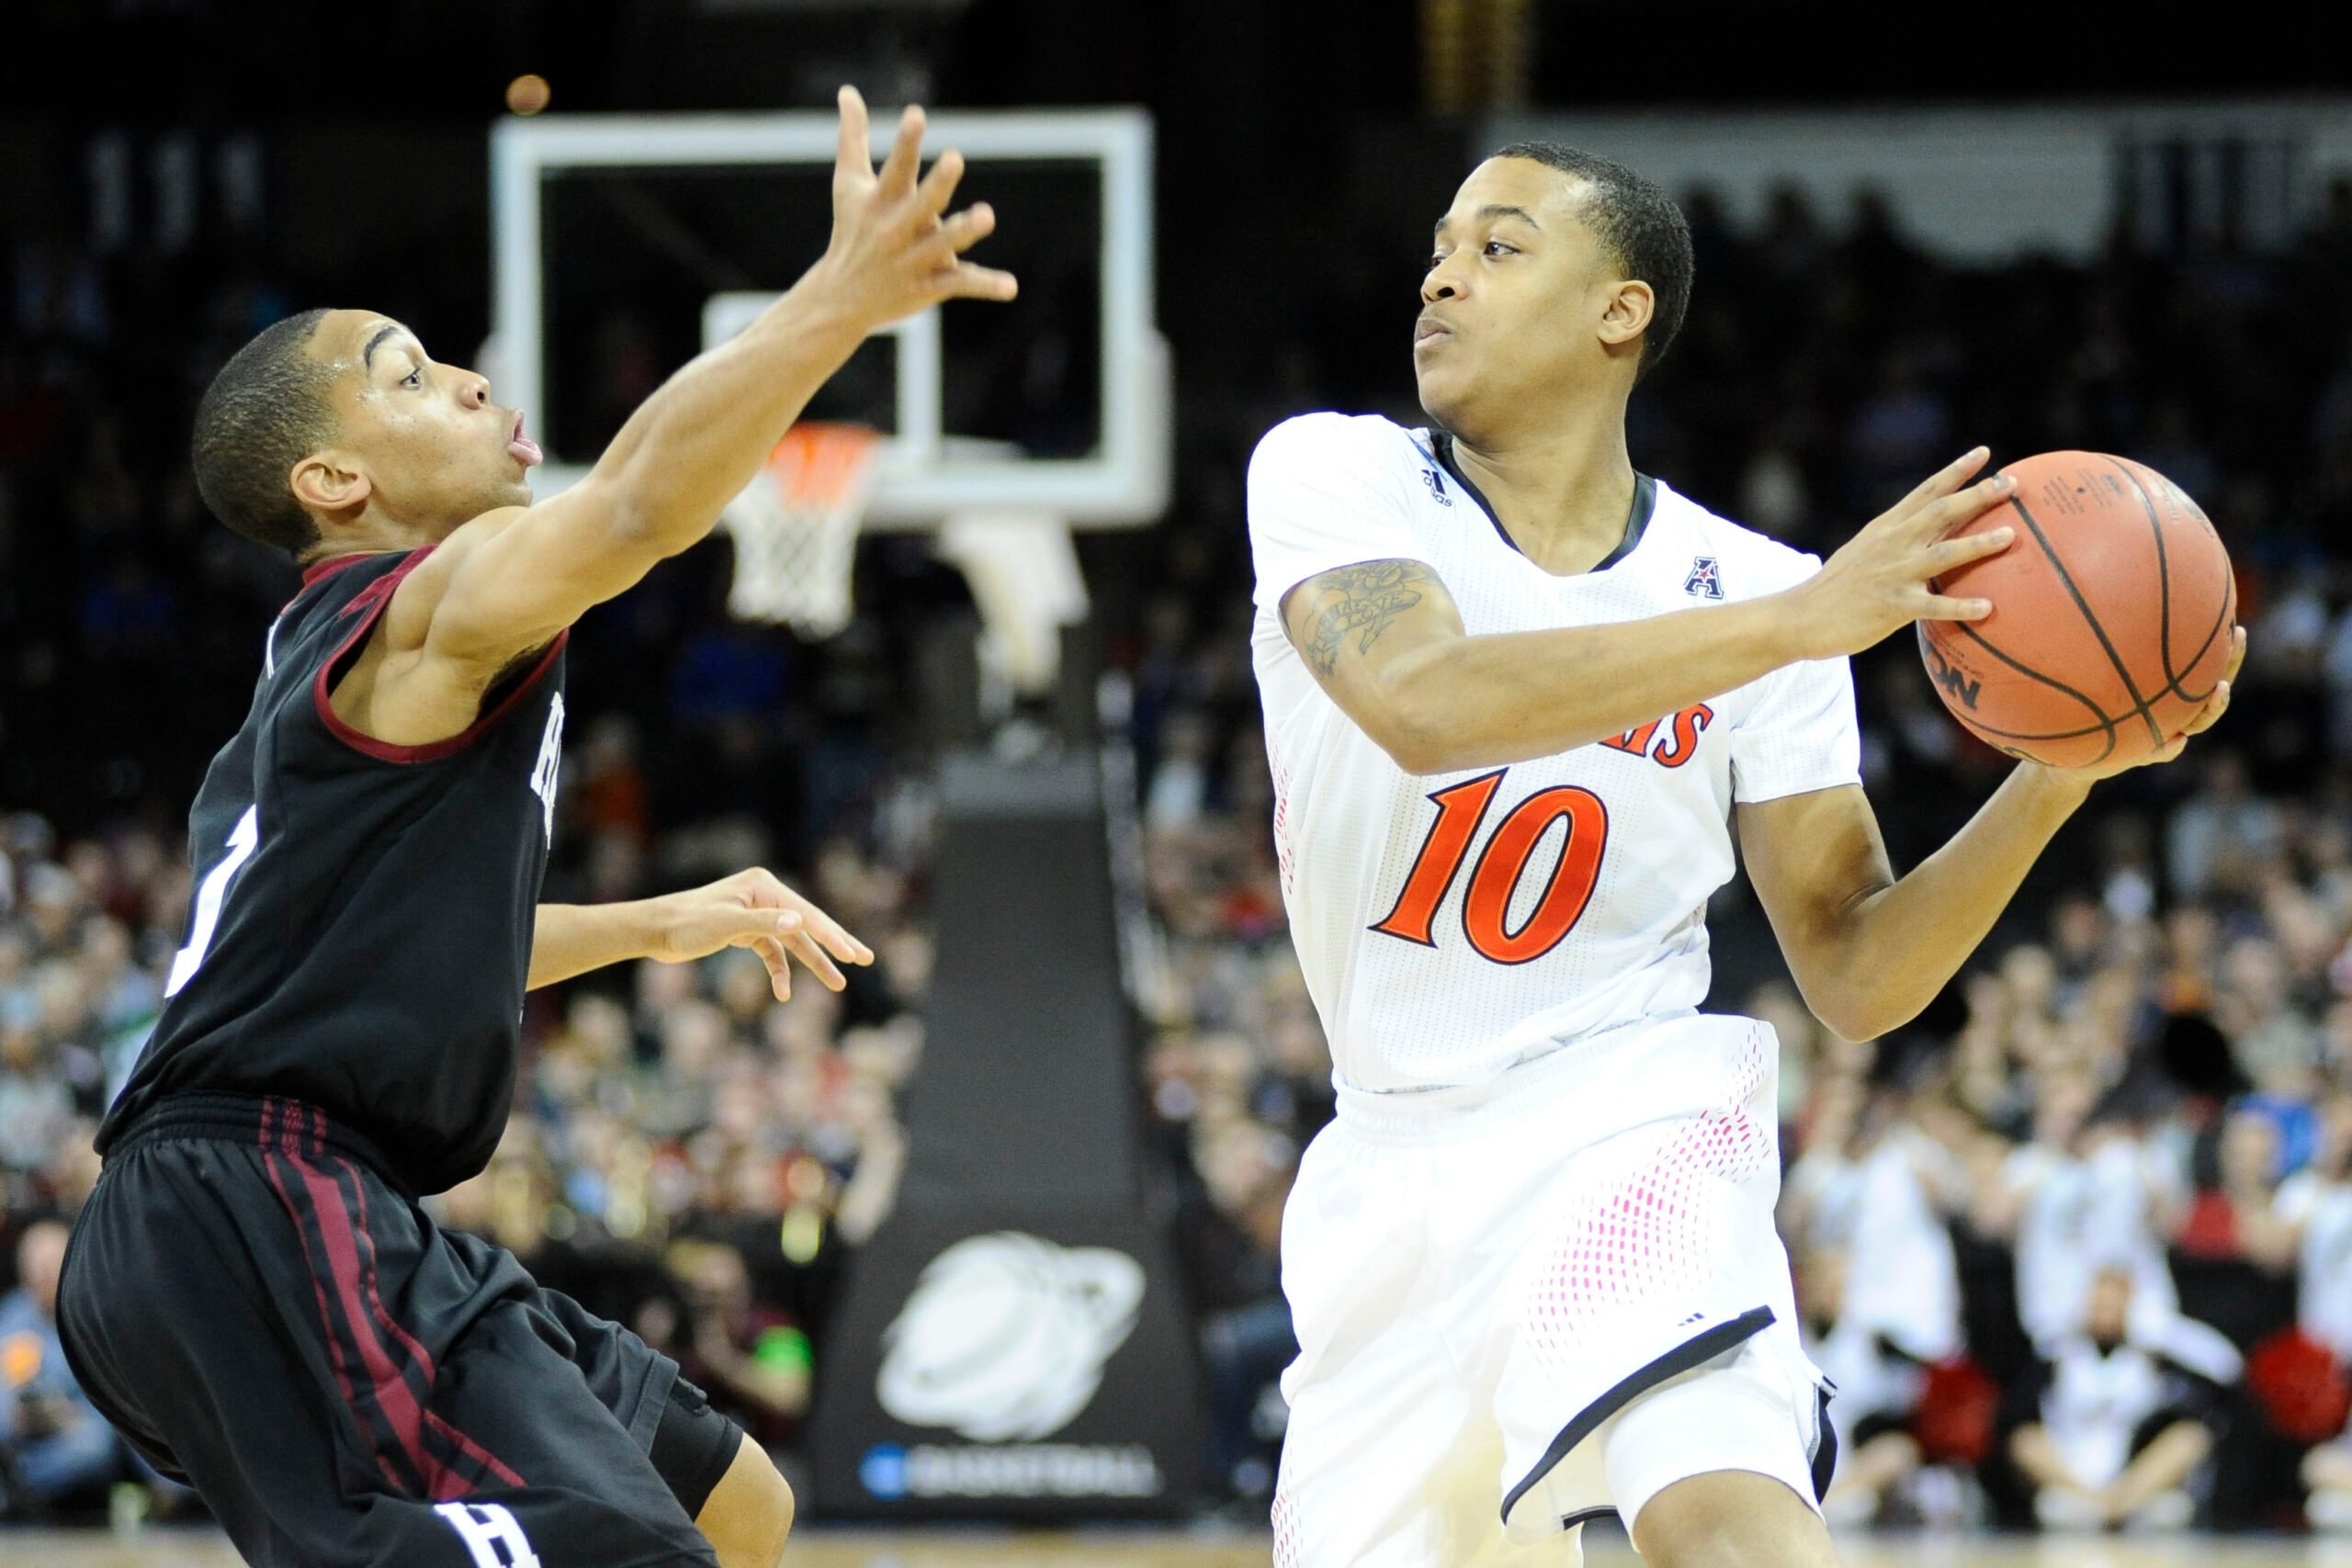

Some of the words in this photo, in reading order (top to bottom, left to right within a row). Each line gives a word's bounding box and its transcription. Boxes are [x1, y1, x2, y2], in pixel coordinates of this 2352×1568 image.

[164, 803, 258, 999] 1
[1367, 767, 1609, 966] 10
[433, 1502, 543, 1568] H
